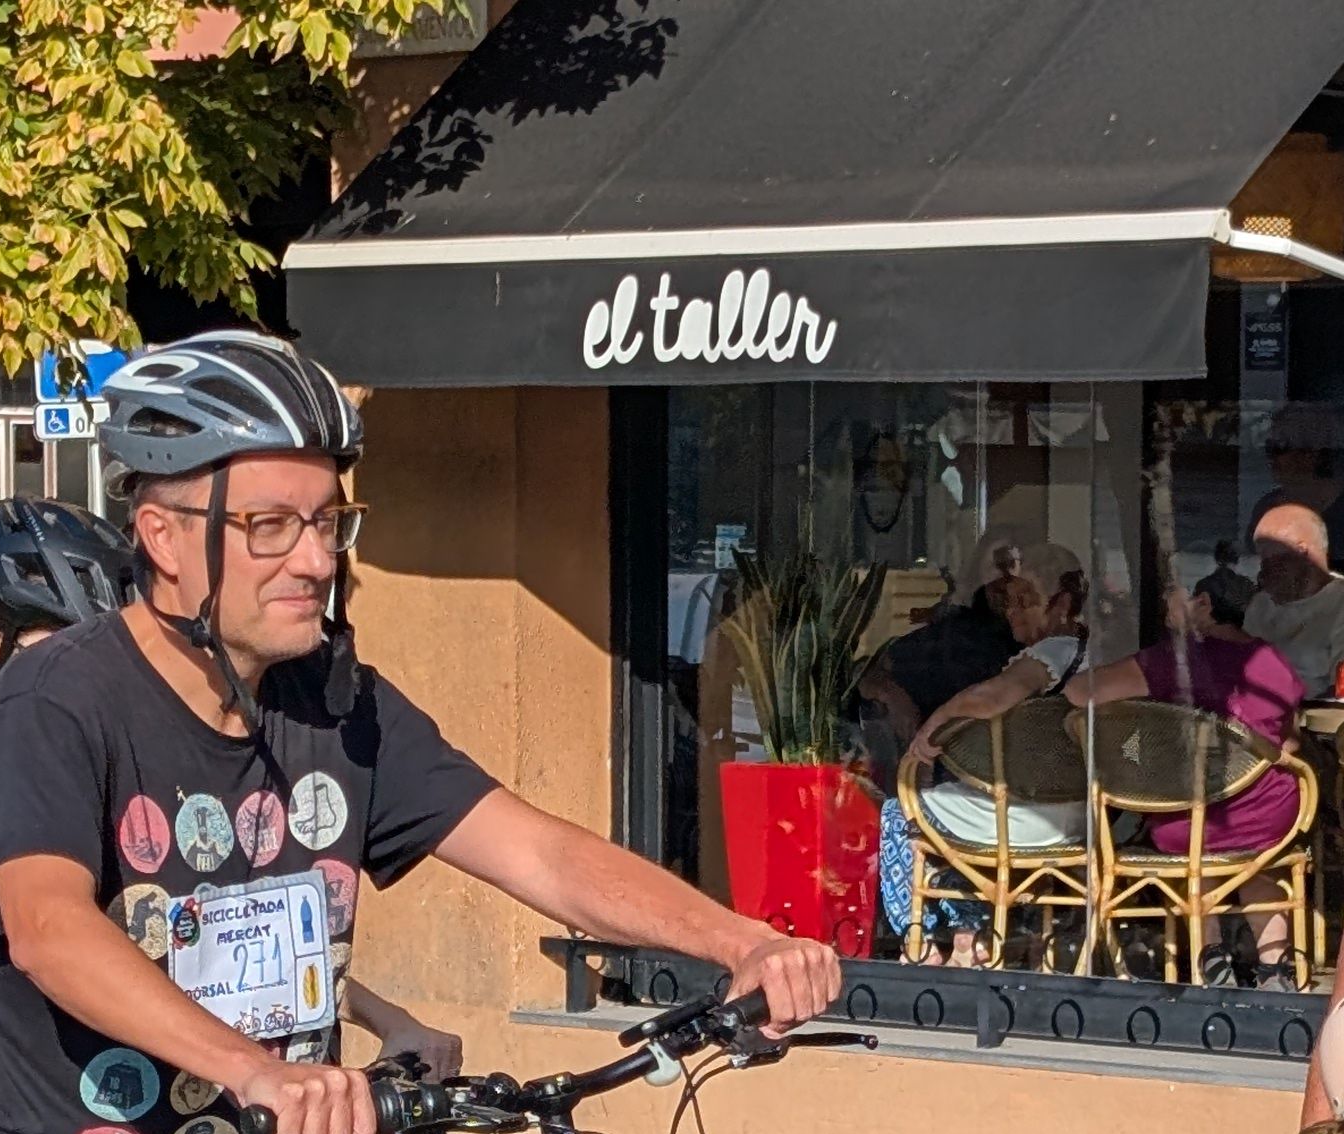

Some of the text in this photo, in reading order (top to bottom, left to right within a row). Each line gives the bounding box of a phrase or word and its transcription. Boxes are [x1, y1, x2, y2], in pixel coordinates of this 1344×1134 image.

[583, 268, 837, 369] el taller
[201, 898, 285, 926] BICICLETADA
[232, 932, 284, 993] 271
